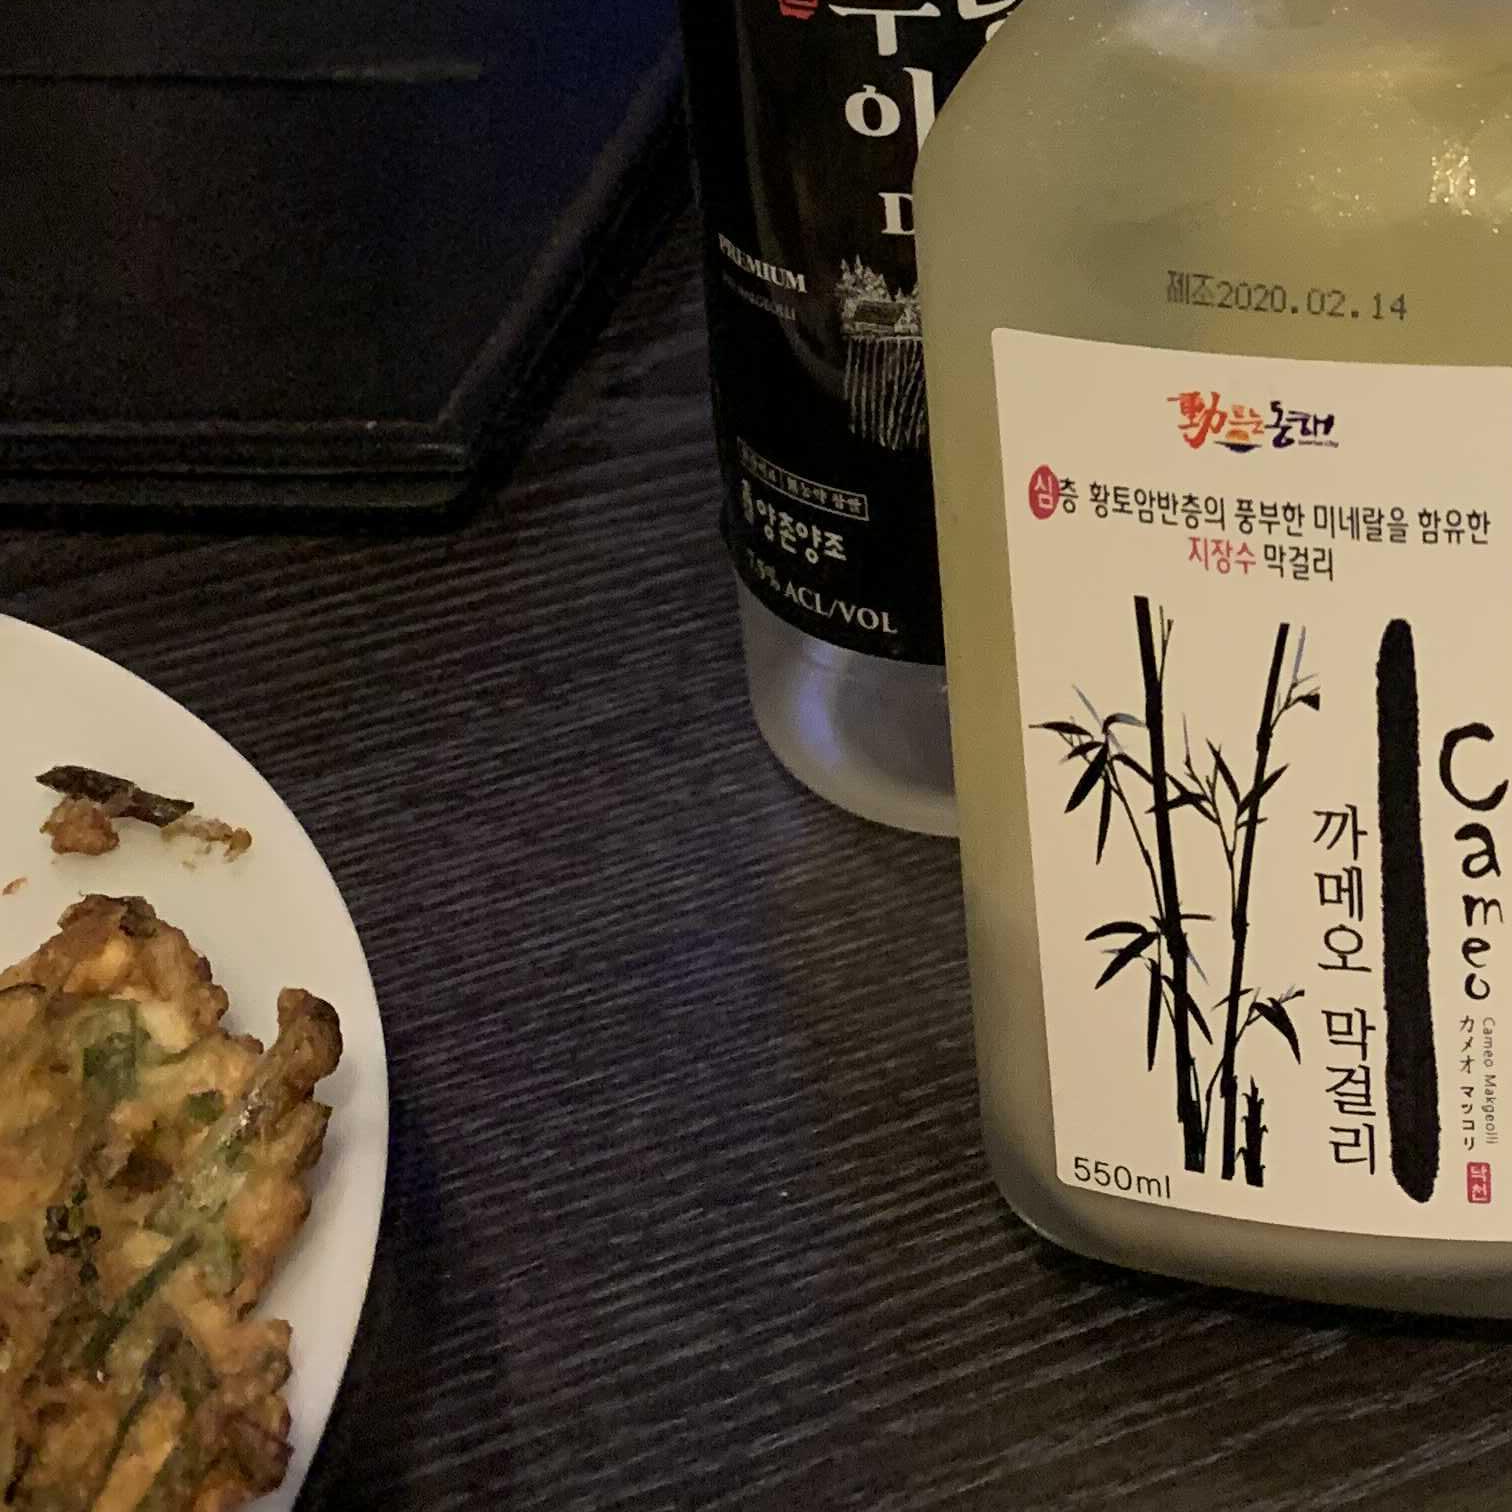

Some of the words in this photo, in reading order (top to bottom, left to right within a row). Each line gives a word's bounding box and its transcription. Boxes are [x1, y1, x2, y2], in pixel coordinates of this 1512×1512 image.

[1166, 269, 1409, 321] 제조2020.02.14
[1088, 480, 1226, 531] 황토암반층의
[1233, 497, 1306, 538] 풍부한
[1313, 503, 1410, 544] 미네랄을
[1418, 507, 1492, 546] 함유한
[1187, 535, 1257, 576] 지장수
[1263, 542, 1335, 582] 막걸리
[1312, 802, 1373, 976] 까메오
[1438, 722, 1510, 1002] Cameo
[1458, 1014, 1476, 1075] カメオ
[1482, 1016, 1497, 1068] Cameo
[1320, 1006, 1377, 1176] 막걸리
[1073, 1155, 1172, 1200] 550ml
